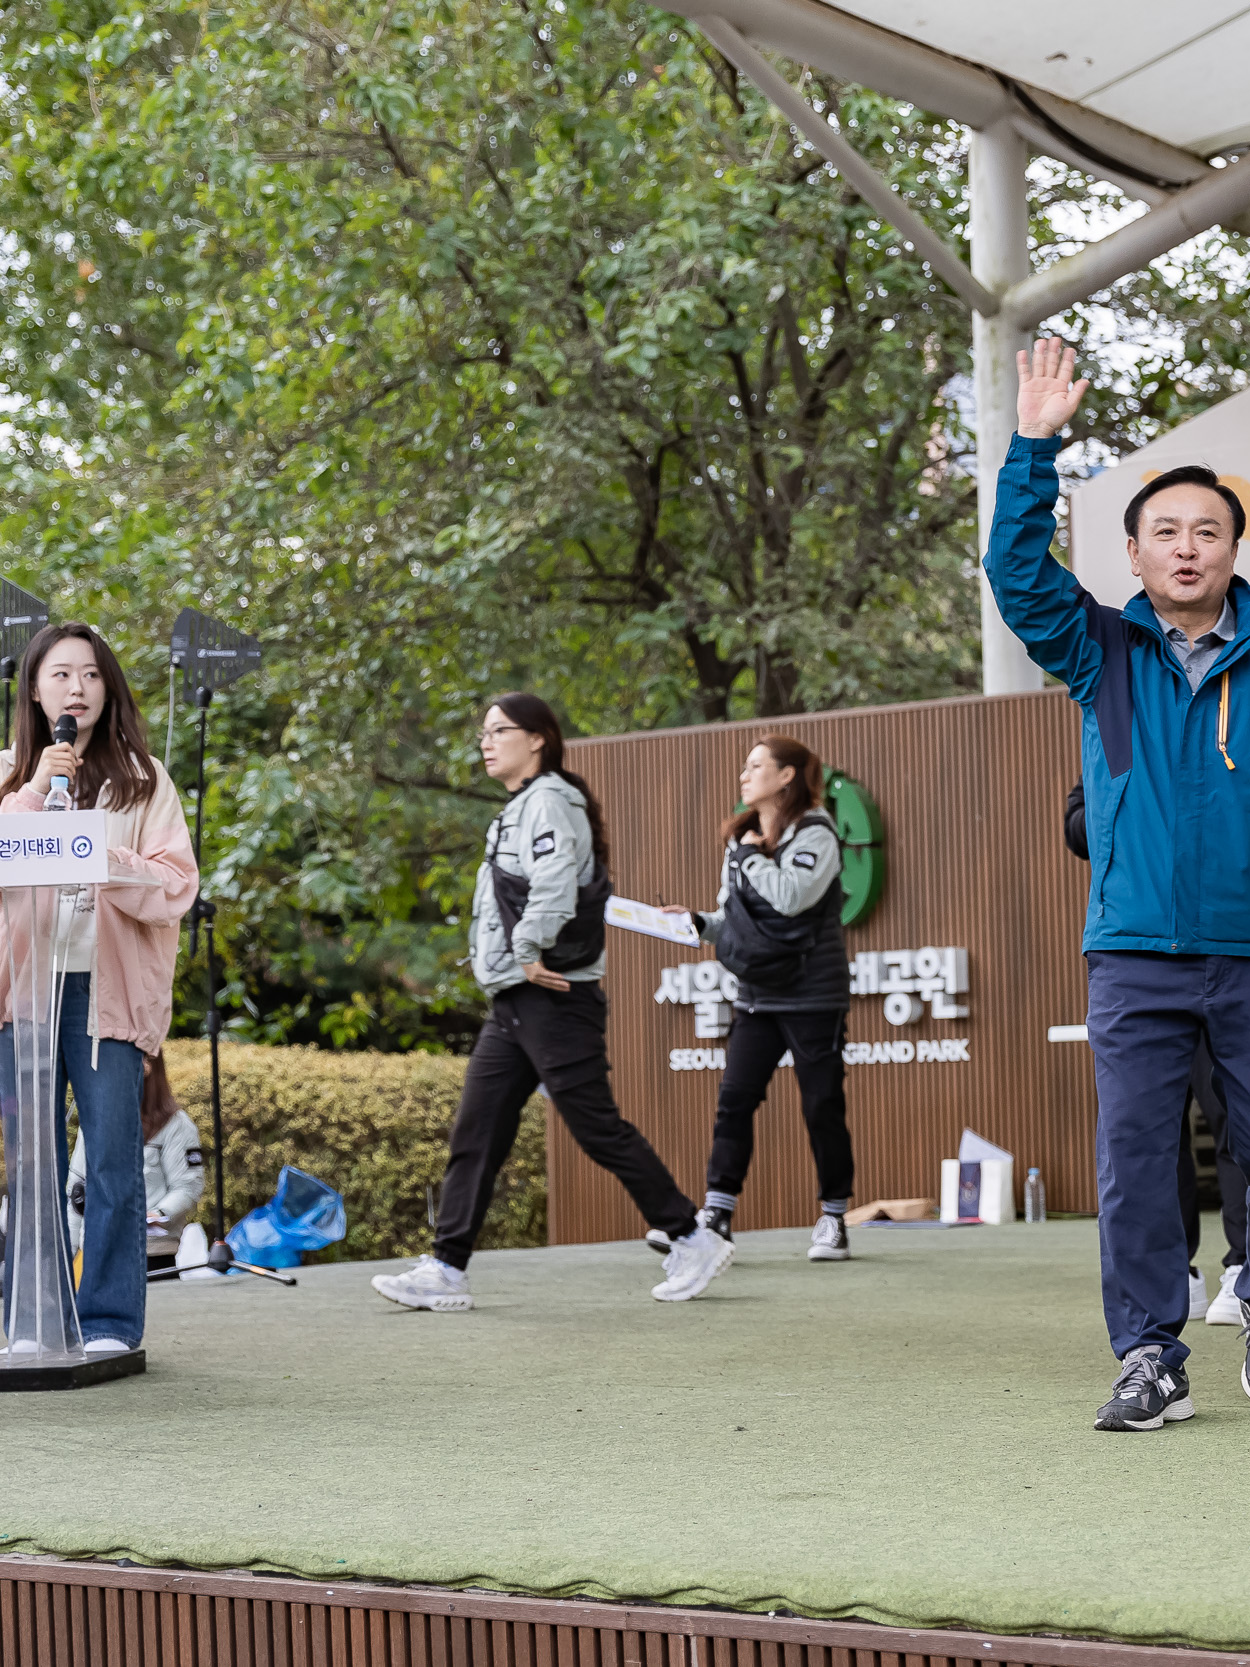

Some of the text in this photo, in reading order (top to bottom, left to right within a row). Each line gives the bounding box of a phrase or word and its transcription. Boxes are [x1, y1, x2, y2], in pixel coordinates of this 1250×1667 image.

[0, 837, 60, 859] 걷기대회
[841, 1040, 915, 1065] GRAND
[916, 1037, 971, 1062] PARK
